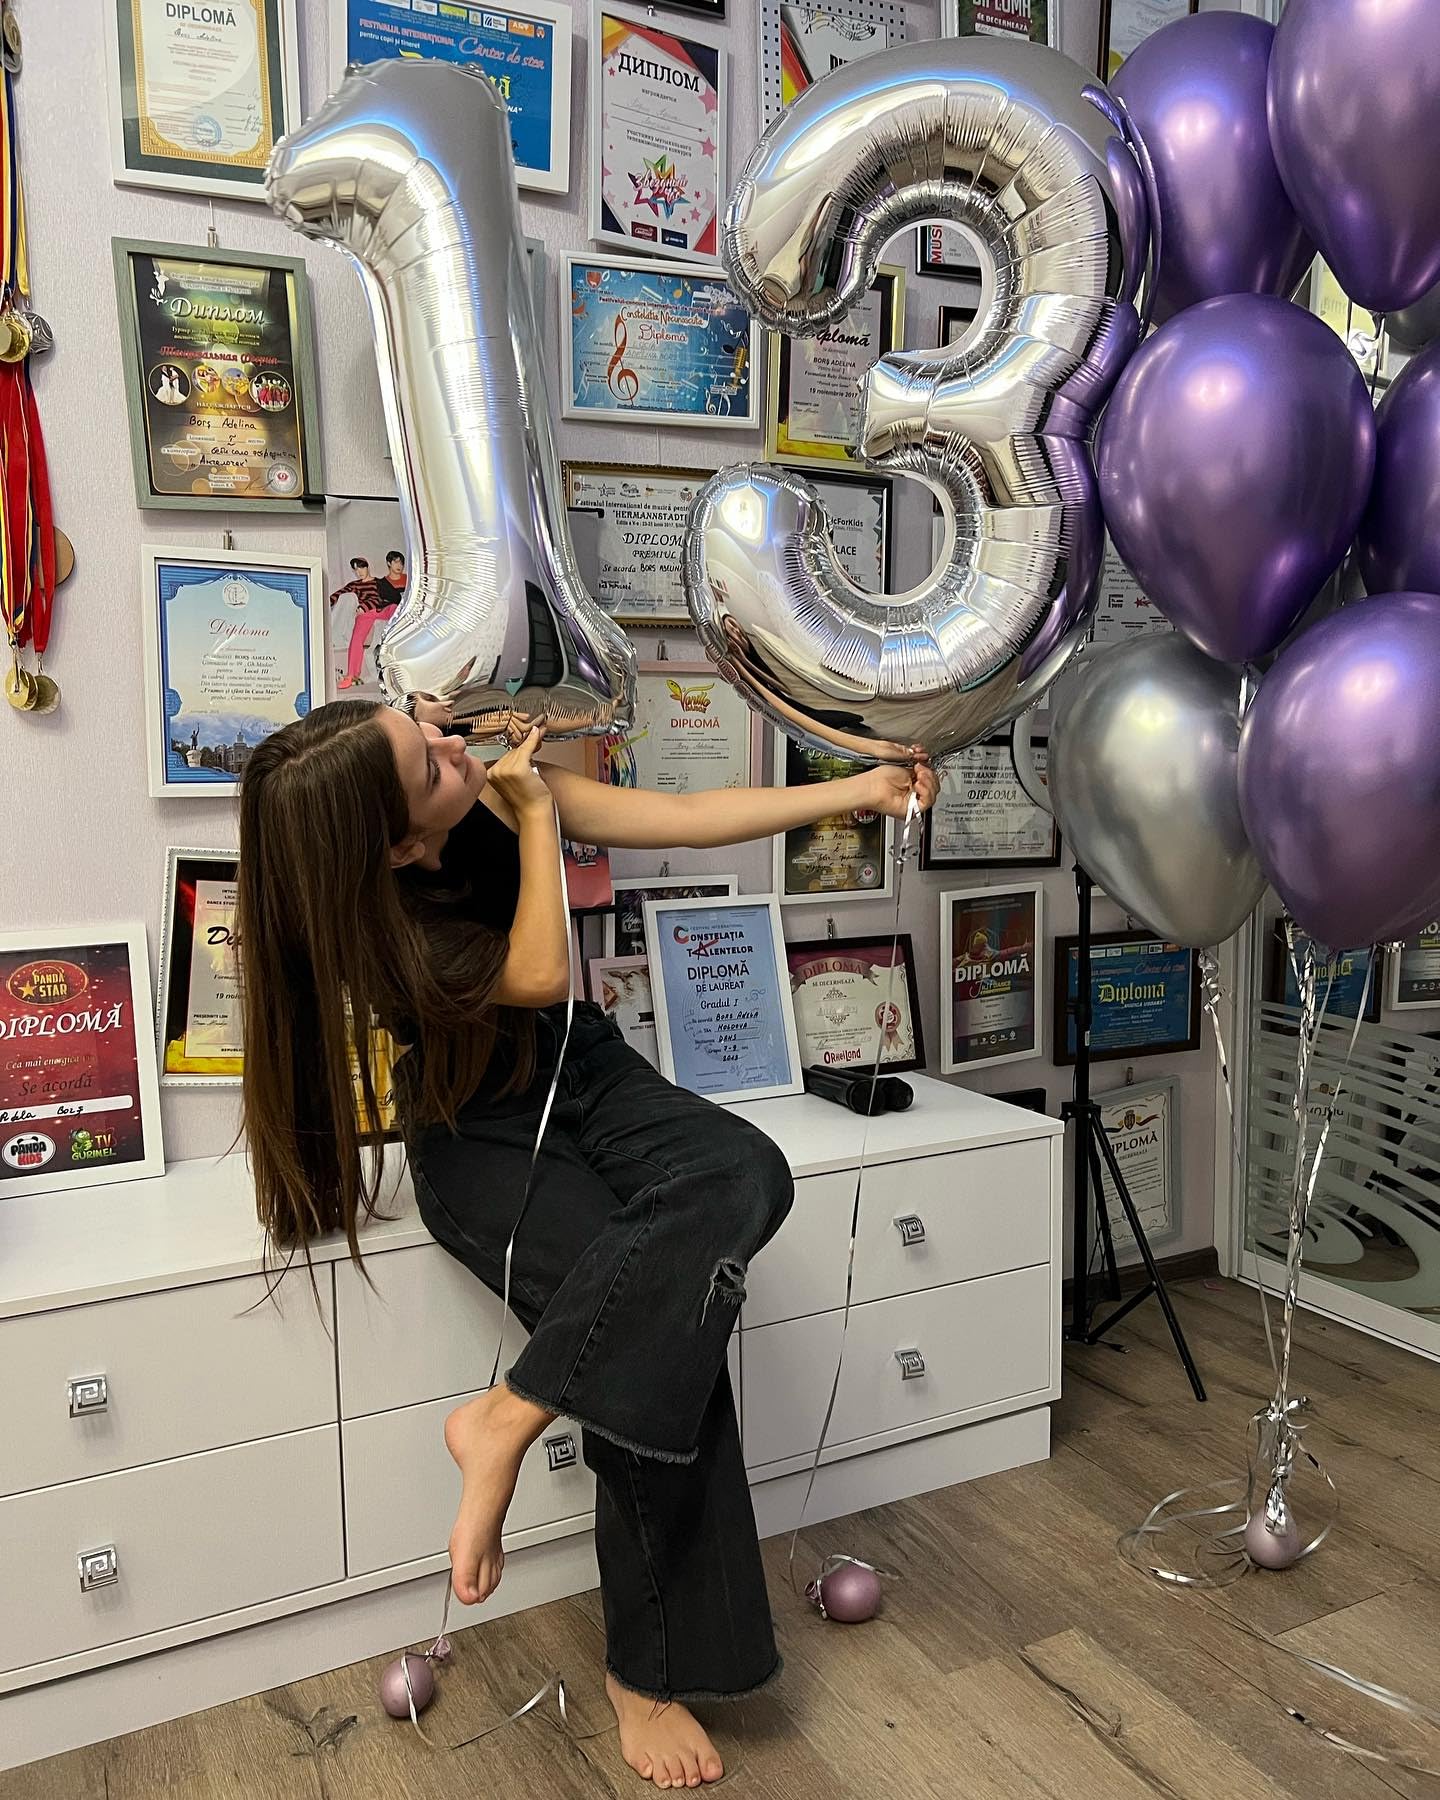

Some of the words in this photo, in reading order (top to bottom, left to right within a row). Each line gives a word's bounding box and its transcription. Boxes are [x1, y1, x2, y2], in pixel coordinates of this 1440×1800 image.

[166, 3, 237, 26] DIPLOMĂ
[359, 31, 380, 40] pentru
[618, 53, 700, 92] ДИПЛОМ
[170, 297, 265, 325] Диплом
[222, 418, 257, 430] Adelina
[623, 532, 684, 548] DIPLOM
[632, 550, 677, 560] PREMIUL
[670, 716, 720, 729] DIPLOMĂ
[687, 960, 750, 980] DIPLOMĂ
[955, 953, 1030, 983] DIPLOMĂ
[33, 972, 65, 985] PANDA
[39, 983, 67, 998] STAR
[695, 982, 707, 993] DE
[709, 980, 745, 992] LAUREAT
[700, 998, 730, 1010] Gradul
[25, 1059, 42, 1069] mai
[18, 1081, 38, 1097] Se
[42, 1072, 93, 1094] acordă
[95, 1133, 113, 1147] TV
[11, 1140, 47, 1157] PANDA
[17, 1152, 43, 1166] KIDS
